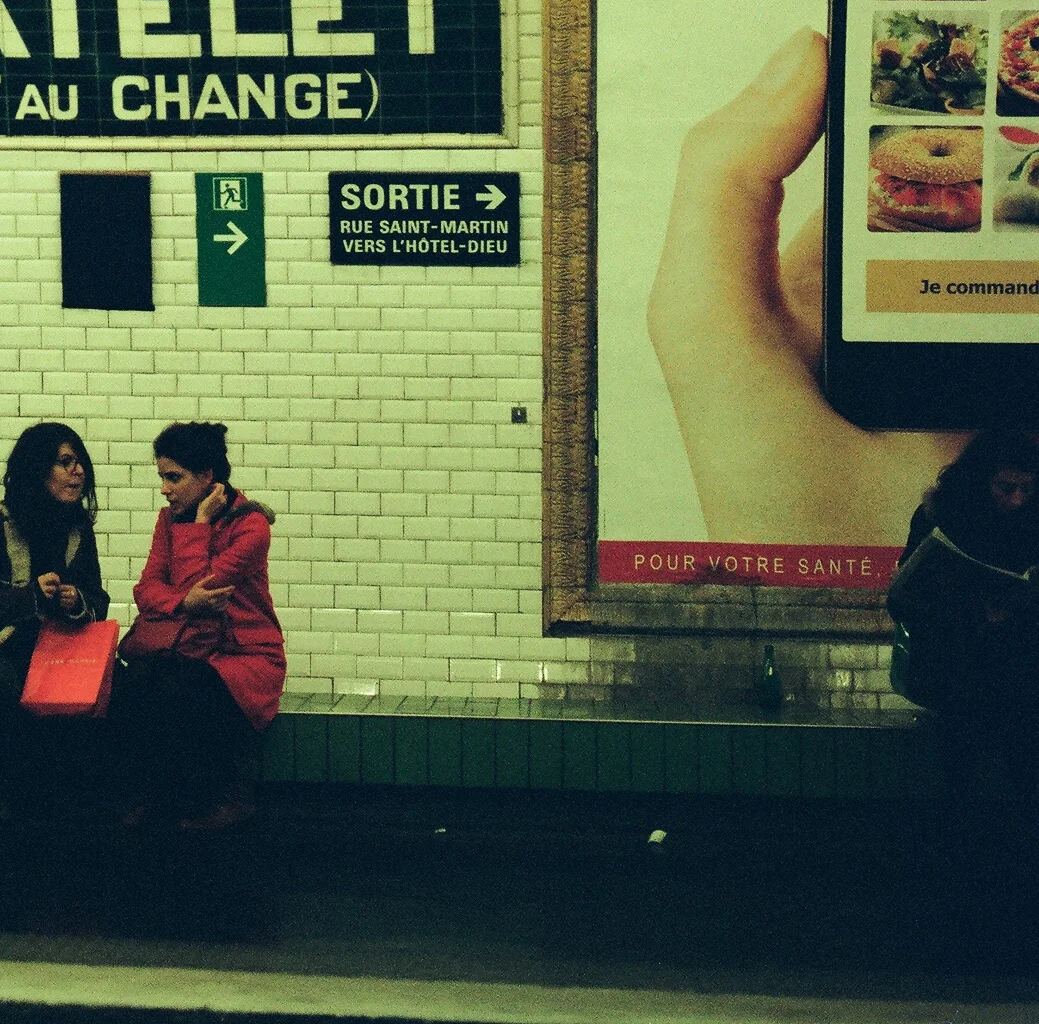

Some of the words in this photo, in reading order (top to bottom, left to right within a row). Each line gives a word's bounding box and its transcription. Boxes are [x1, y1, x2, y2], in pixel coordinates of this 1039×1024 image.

[16, 83, 79, 121] AU
[111, 70, 380, 121] CHANGE)
[341, 183, 460, 210] SORTIE
[340, 220, 373, 234] RUE
[379, 220, 508, 234] SAINT-MARTIN
[343, 239, 386, 253] VERS
[392, 237, 508, 253] L'HÔTEL-DIEU
[920, 279, 941, 294] Je
[946, 280, 1039, 295] command
[634, 554, 695, 571] POUR
[709, 555, 784, 574] VOTRE
